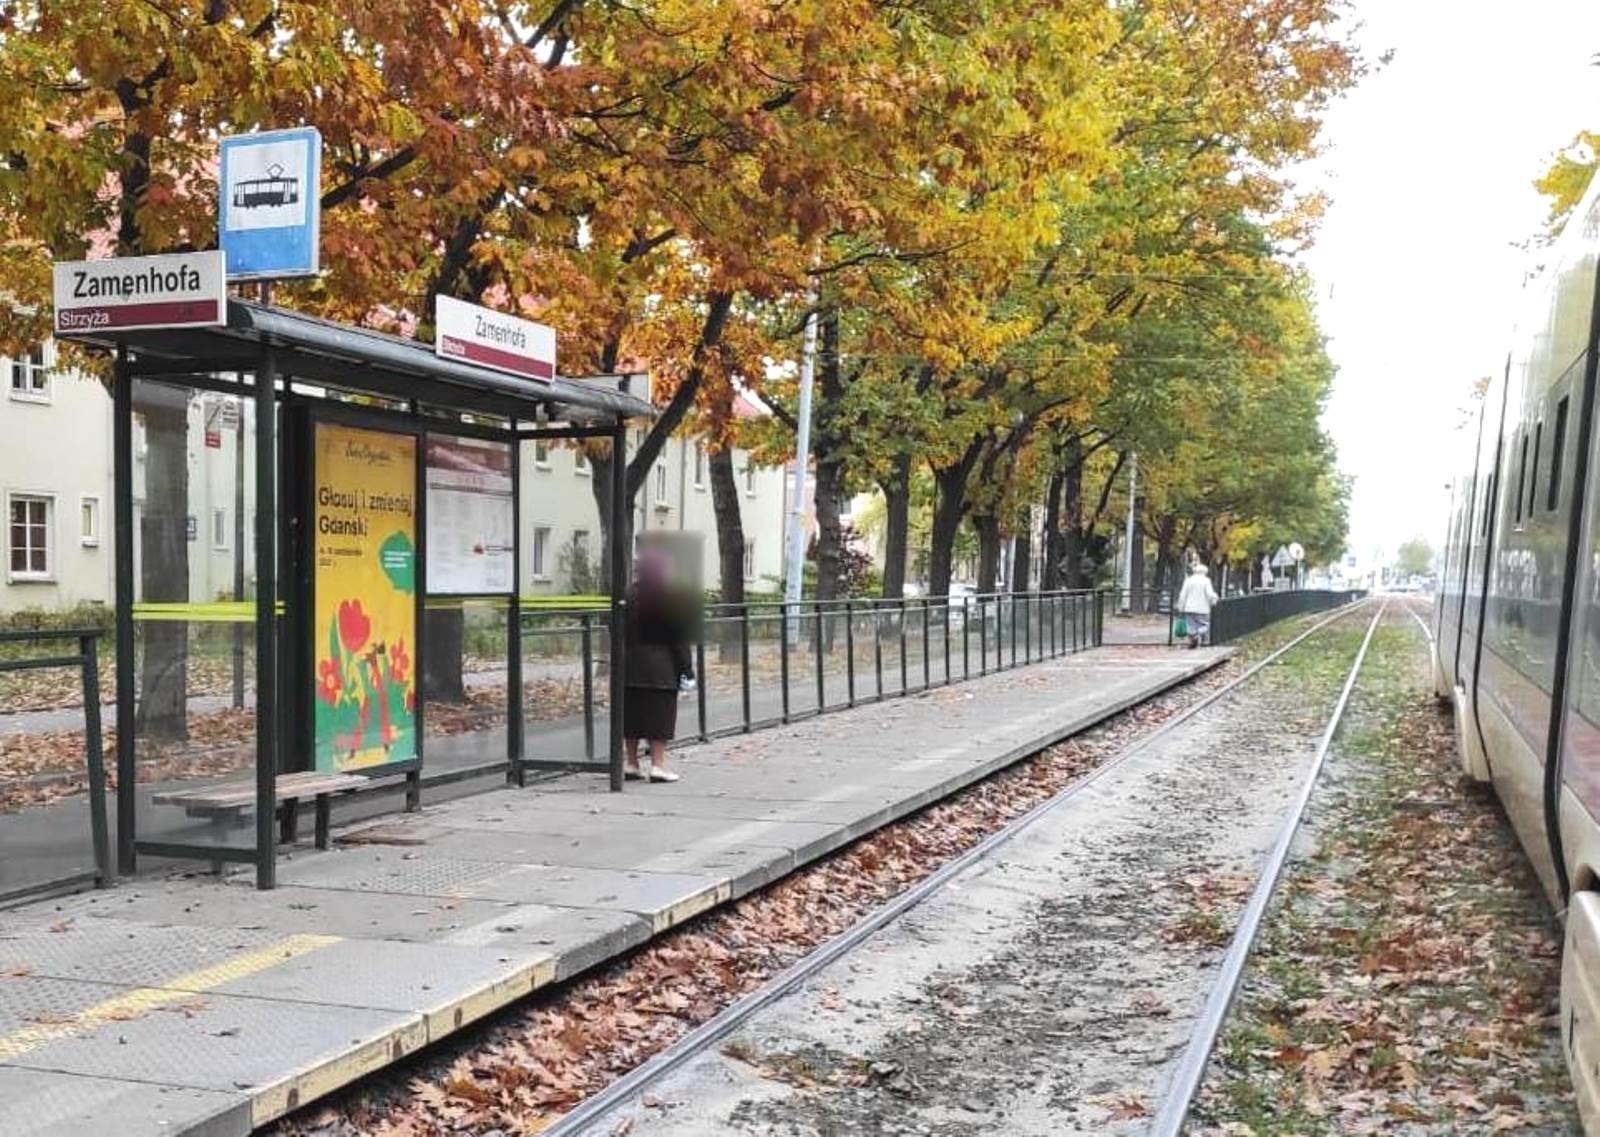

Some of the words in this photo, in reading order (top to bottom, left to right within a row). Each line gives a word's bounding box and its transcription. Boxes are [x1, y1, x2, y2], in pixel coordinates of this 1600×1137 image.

[74, 264, 200, 298] Zamenhofa
[60, 311, 109, 329] Strzyża
[476, 315, 526, 349] Zamenhofa
